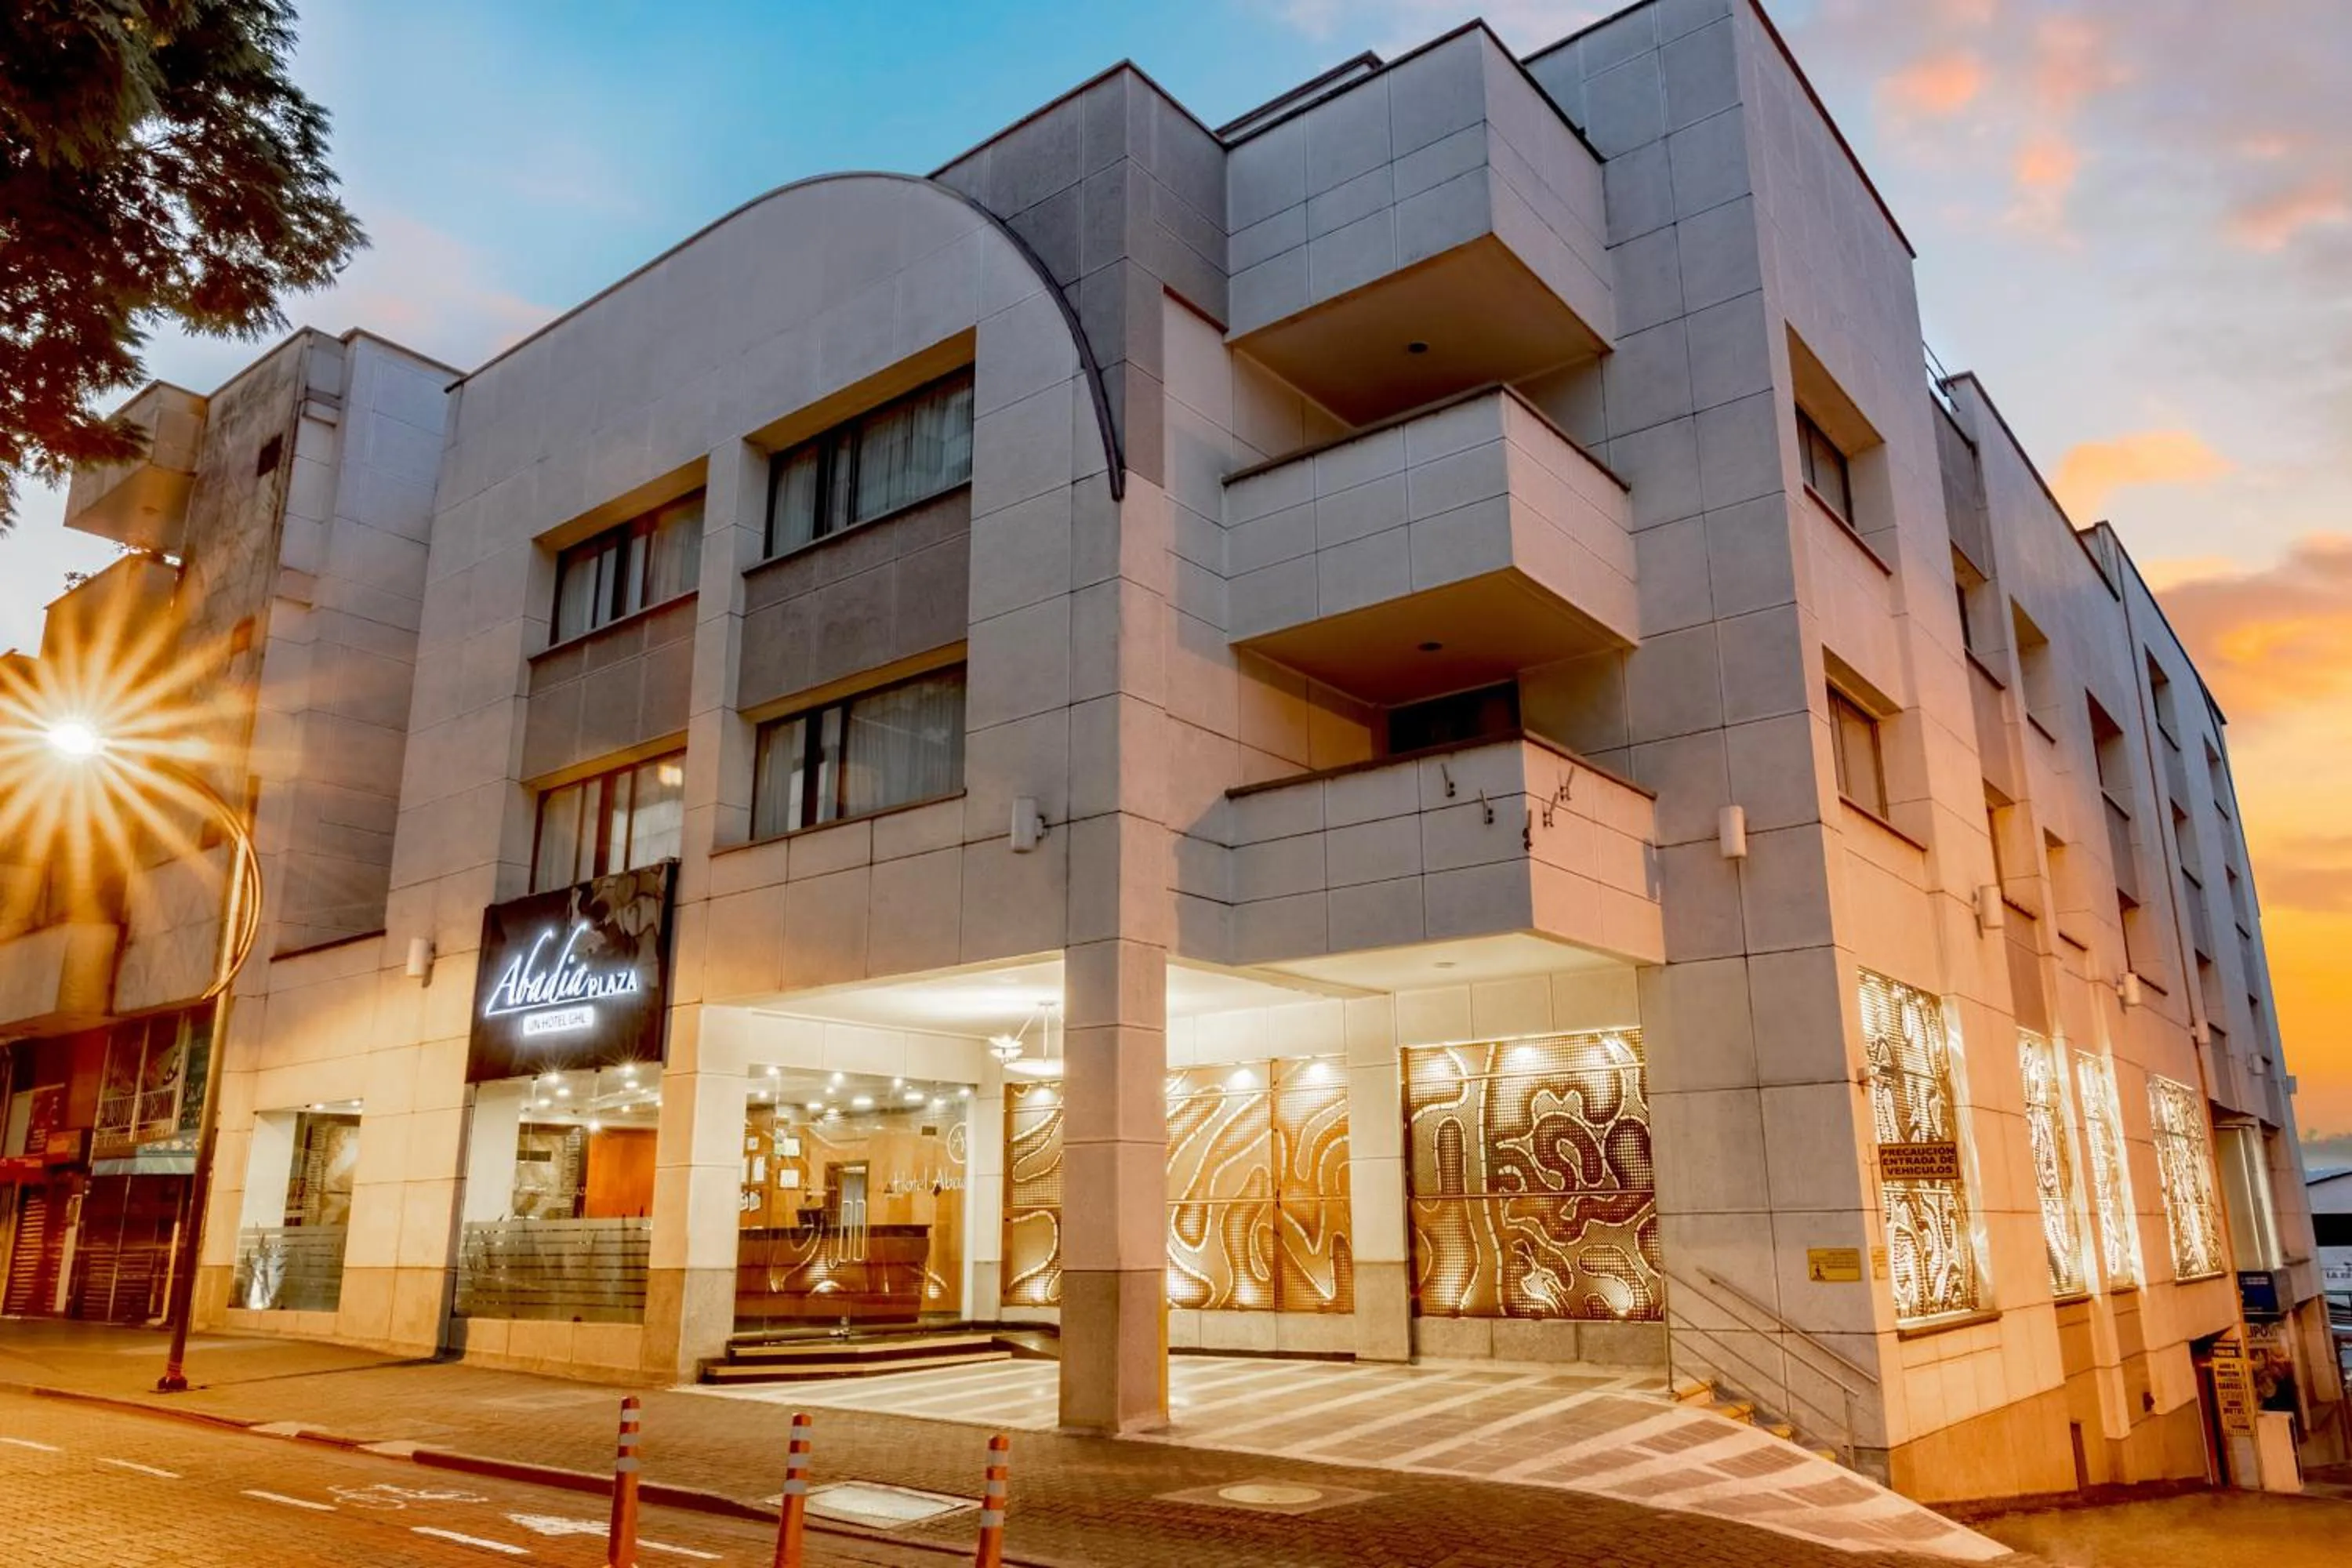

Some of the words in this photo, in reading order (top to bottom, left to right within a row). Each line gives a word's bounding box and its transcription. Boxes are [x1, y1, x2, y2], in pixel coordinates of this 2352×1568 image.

[589, 969, 638, 996] PLAZA
[542, 1014, 567, 1029] HOTEL
[1882, 1147, 1955, 1156] PRECAUCION
[1883, 1156, 1936, 1166] ENTRADA
[1940, 1156, 1955, 1164] DE
[1887, 1166, 1953, 1175] VEHICULOS
[892, 1166, 927, 1192] Hotel
